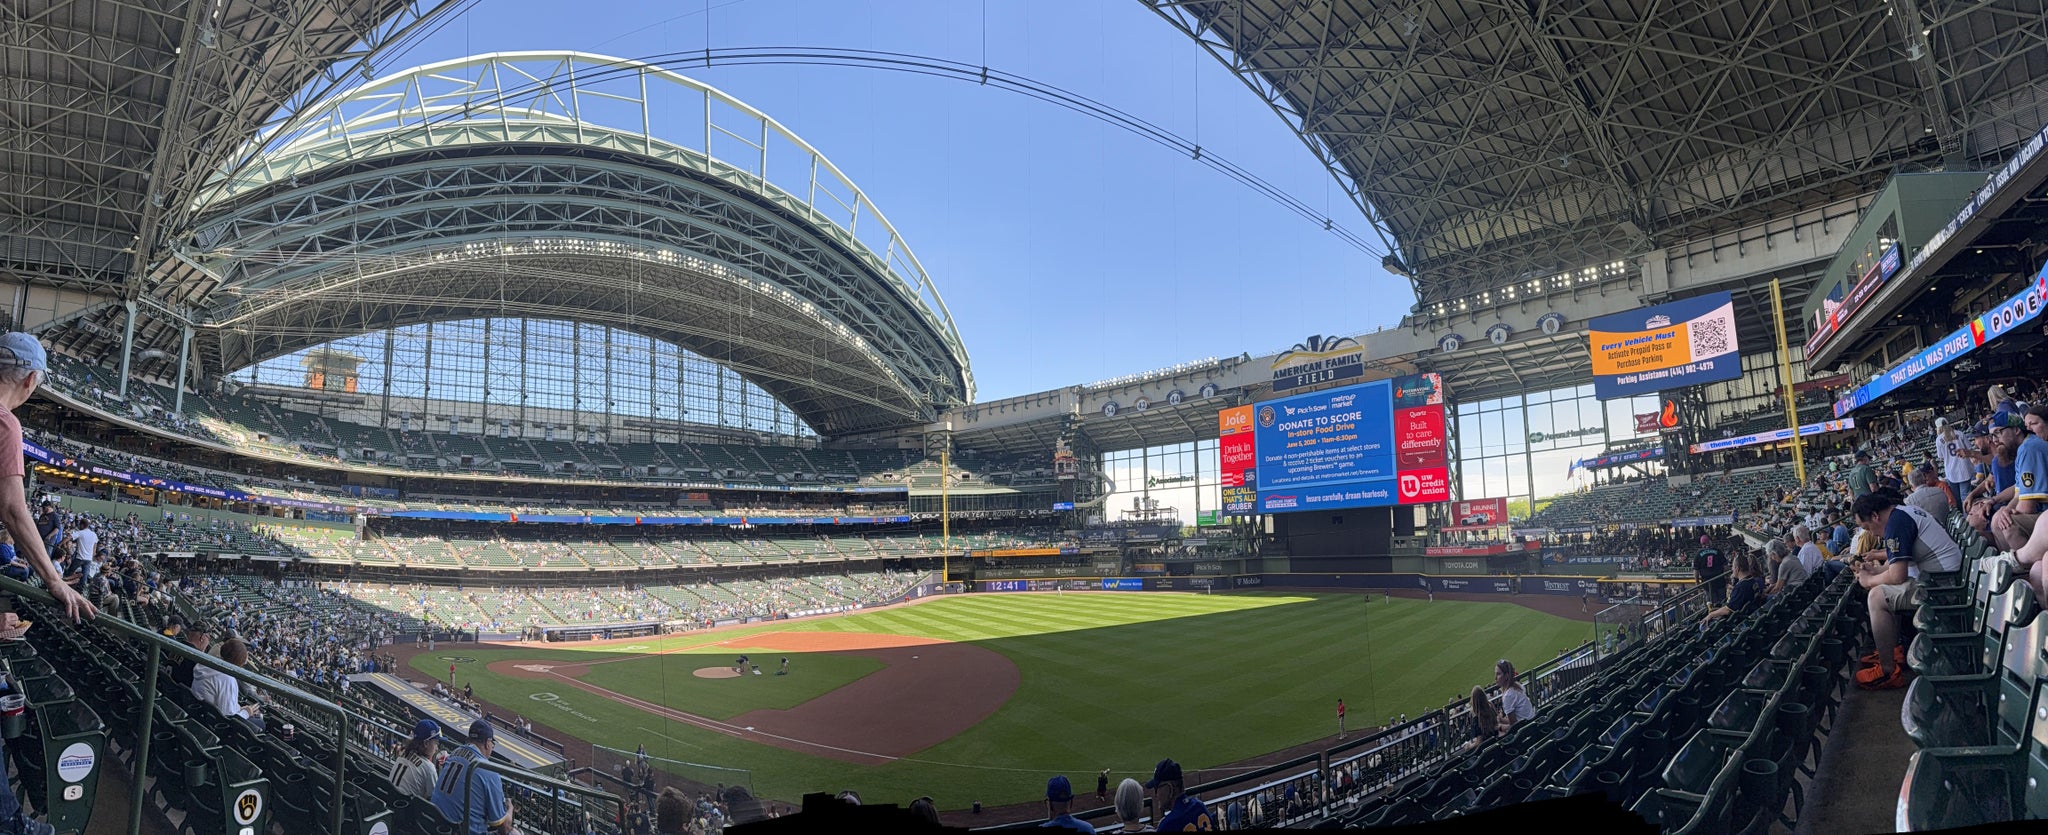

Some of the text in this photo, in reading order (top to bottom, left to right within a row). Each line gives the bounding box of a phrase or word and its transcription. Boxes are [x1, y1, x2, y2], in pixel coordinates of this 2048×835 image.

[2018, 133, 2044, 166] LOCATION
[1446, 341, 1455, 350] 19
[1601, 331, 1676, 351] Every Vehicle Must
[1608, 348, 1630, 361] Activate
[1630, 346, 1651, 357] Prepaid
[1652, 343, 1665, 352] Pass
[1617, 354, 1663, 369] Purchase Parking
[1890, 333, 1970, 386] THAT BALL WAS PURE
[1273, 353, 1363, 380] AMERICAN FAMILY
[1297, 370, 1334, 386] FIELD
[1617, 375, 1638, 385] Parking
[1638, 370, 1669, 382] Assistance
[1670, 366, 1685, 378] (414)
[1331, 401, 1353, 409] market
[1410, 410, 1427, 418] Quartz
[1279, 411, 1362, 431] DONATE TO SCORE
[1410, 421, 1427, 430] Built
[1287, 423, 1355, 438] In-store Food Drive
[1415, 430, 1433, 438] care
[1224, 442, 1251, 455] Drink in
[1401, 438, 1442, 449] differently
[1710, 436, 1757, 449] theme nights
[1265, 455, 1283, 463] Donate
[1288, 450, 1324, 459] non-perishable
[1347, 445, 1363, 453] select
[1363, 443, 1381, 451] stores
[1948, 442, 1957, 457] 8
[1223, 451, 1254, 465] Together
[1288, 459, 1305, 467] receive
[1309, 456, 1324, 464] ticket
[1324, 454, 1349, 462] vouchers
[1288, 465, 1313, 474] upcoming
[1155, 477, 1180, 485] Associated
[1421, 479, 1445, 487] credit
[1223, 489, 1235, 497] ONE
[1305, 488, 1388, 503] Insure carefully, dream fearlessly.
[1422, 487, 1446, 495] union
[1223, 495, 1243, 504] THAT'S
[1227, 502, 1253, 511] GRUBER
[950, 511, 971, 519] OPEN
[1608, 523, 1620, 531] 620
[1620, 522, 1638, 530] WTMJ
[1707, 555, 1714, 568] 8
[991, 581, 1019, 591] 12:41
[1242, 577, 1261, 585] Mobile
[1544, 580, 1569, 589] WINTRUST
[391, 763, 408, 787] 11
[440, 760, 464, 794] 11
[70, 788, 76, 798] 5
